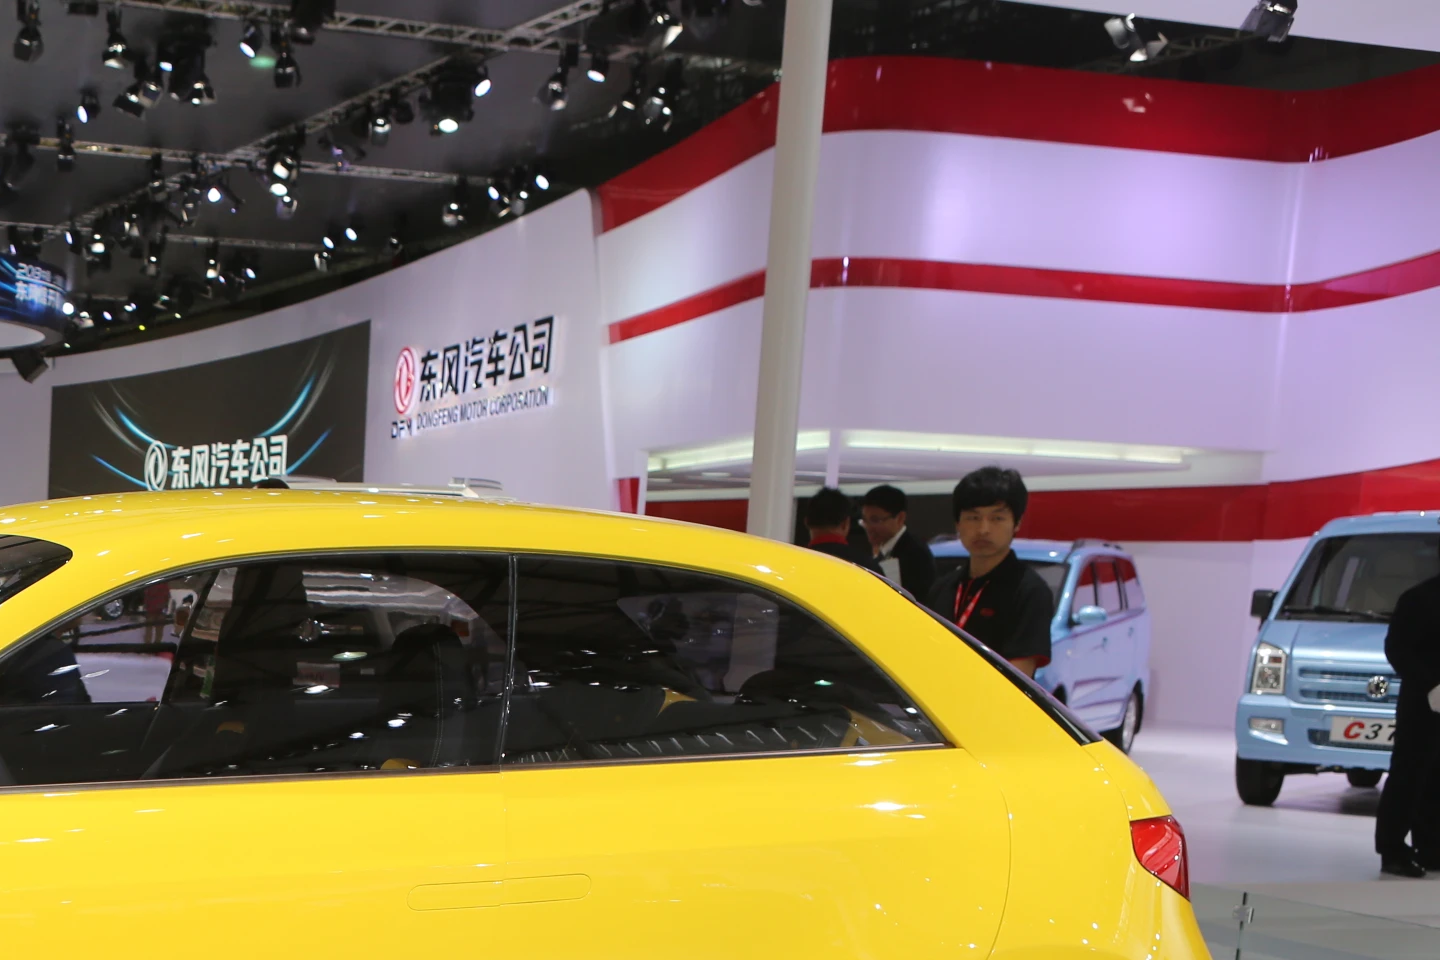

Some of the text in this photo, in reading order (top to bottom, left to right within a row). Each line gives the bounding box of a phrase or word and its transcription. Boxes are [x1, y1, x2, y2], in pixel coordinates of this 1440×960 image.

[420, 315, 555, 402] 东风汽车公司
[416, 405, 459, 430] DONGFENG
[459, 400, 489, 422] MOTOR
[489, 386, 550, 415] CORPORATION
[171, 434, 288, 489] 东风汽车公司
